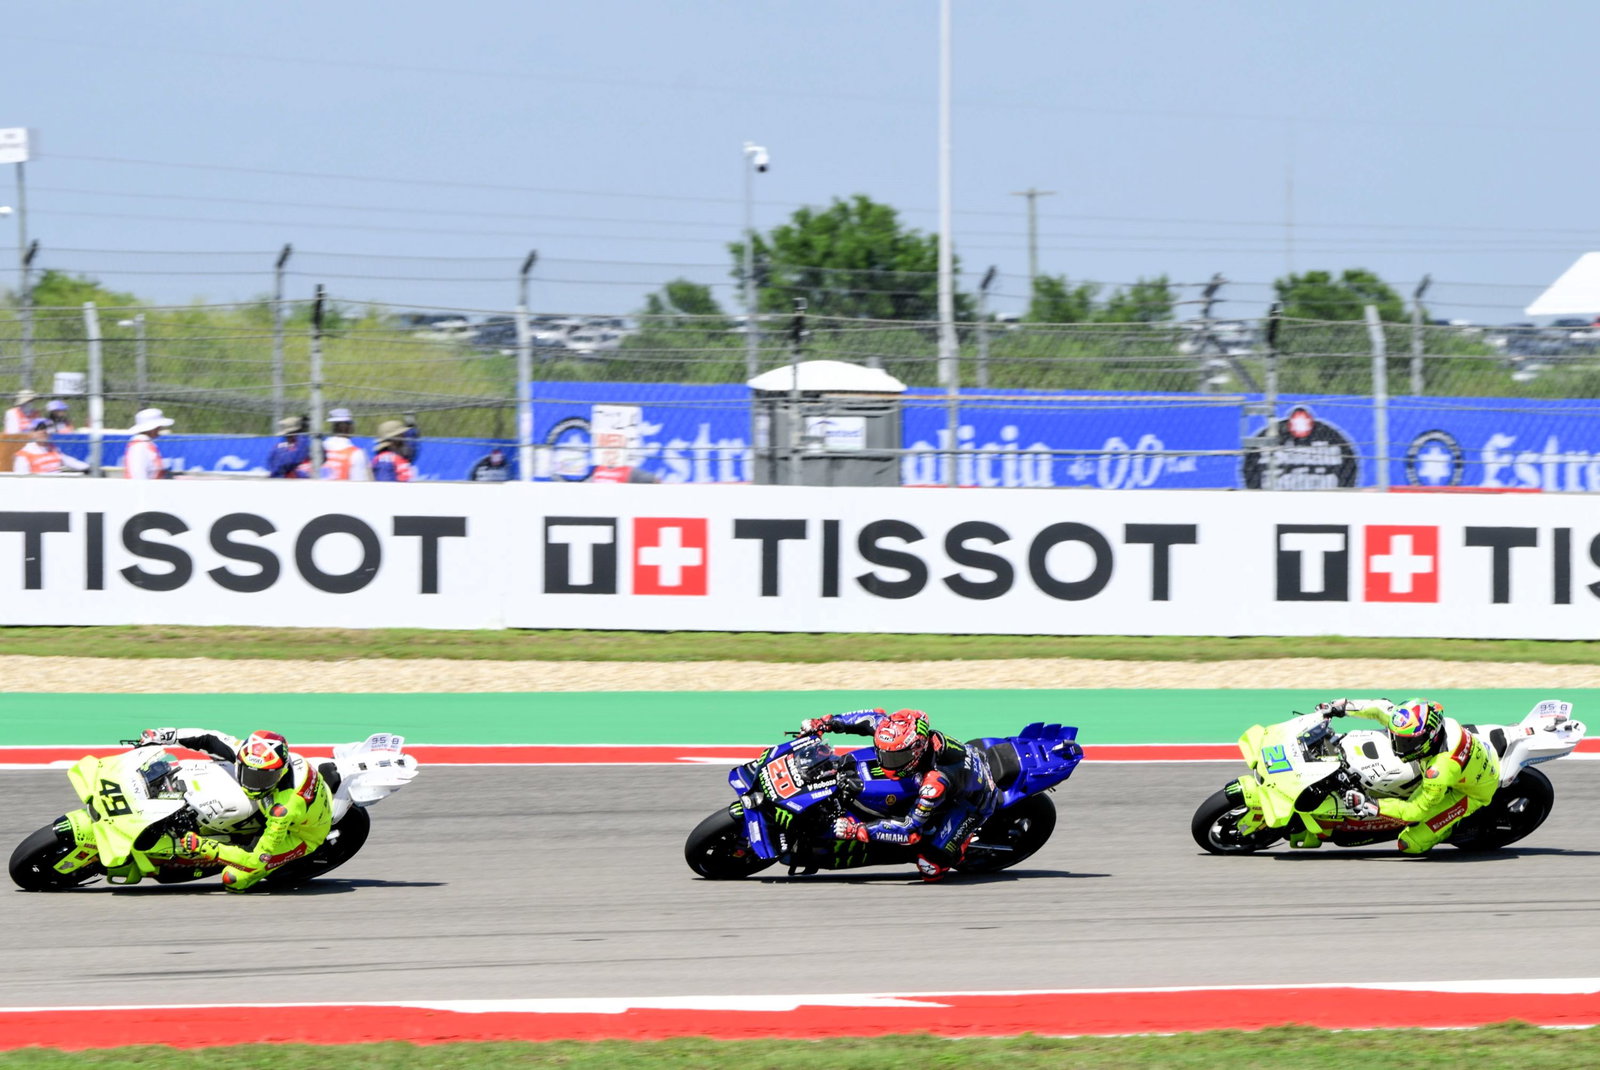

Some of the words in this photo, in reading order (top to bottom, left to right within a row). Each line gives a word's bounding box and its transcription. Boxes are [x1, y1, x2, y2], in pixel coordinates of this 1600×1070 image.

[0, 510, 467, 594] TISSOT
[734, 518, 1198, 601] TISSOT
[1463, 525, 1600, 605] TI
[767, 757, 800, 799] 20
[787, 757, 805, 787] ENEOS
[1261, 744, 1294, 775] 21
[99, 779, 133, 817] 49
[876, 831, 908, 842] YAMAHA
